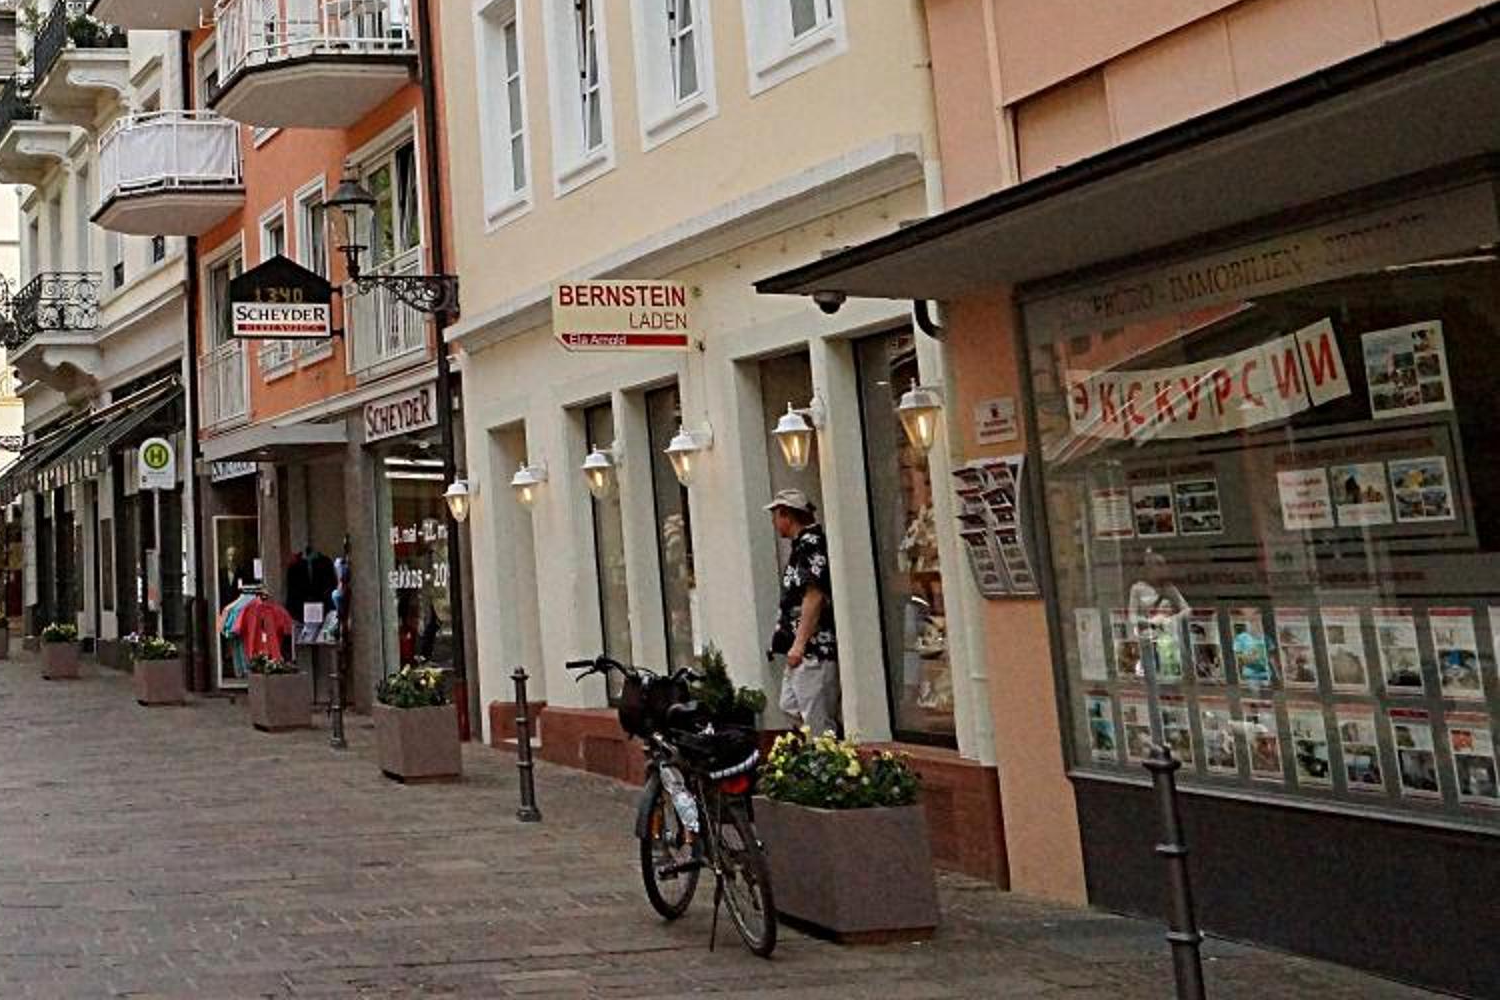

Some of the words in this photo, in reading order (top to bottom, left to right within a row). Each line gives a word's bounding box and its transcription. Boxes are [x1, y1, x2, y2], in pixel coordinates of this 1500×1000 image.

[559, 285, 686, 307] BERNSTEIN
[236, 305, 325, 321] SCHEYDER
[629, 311, 687, 329] LADEN
[1072, 331, 1338, 424] ЭКСКУРСИИ
[364, 388, 432, 437] SCHEYDER
